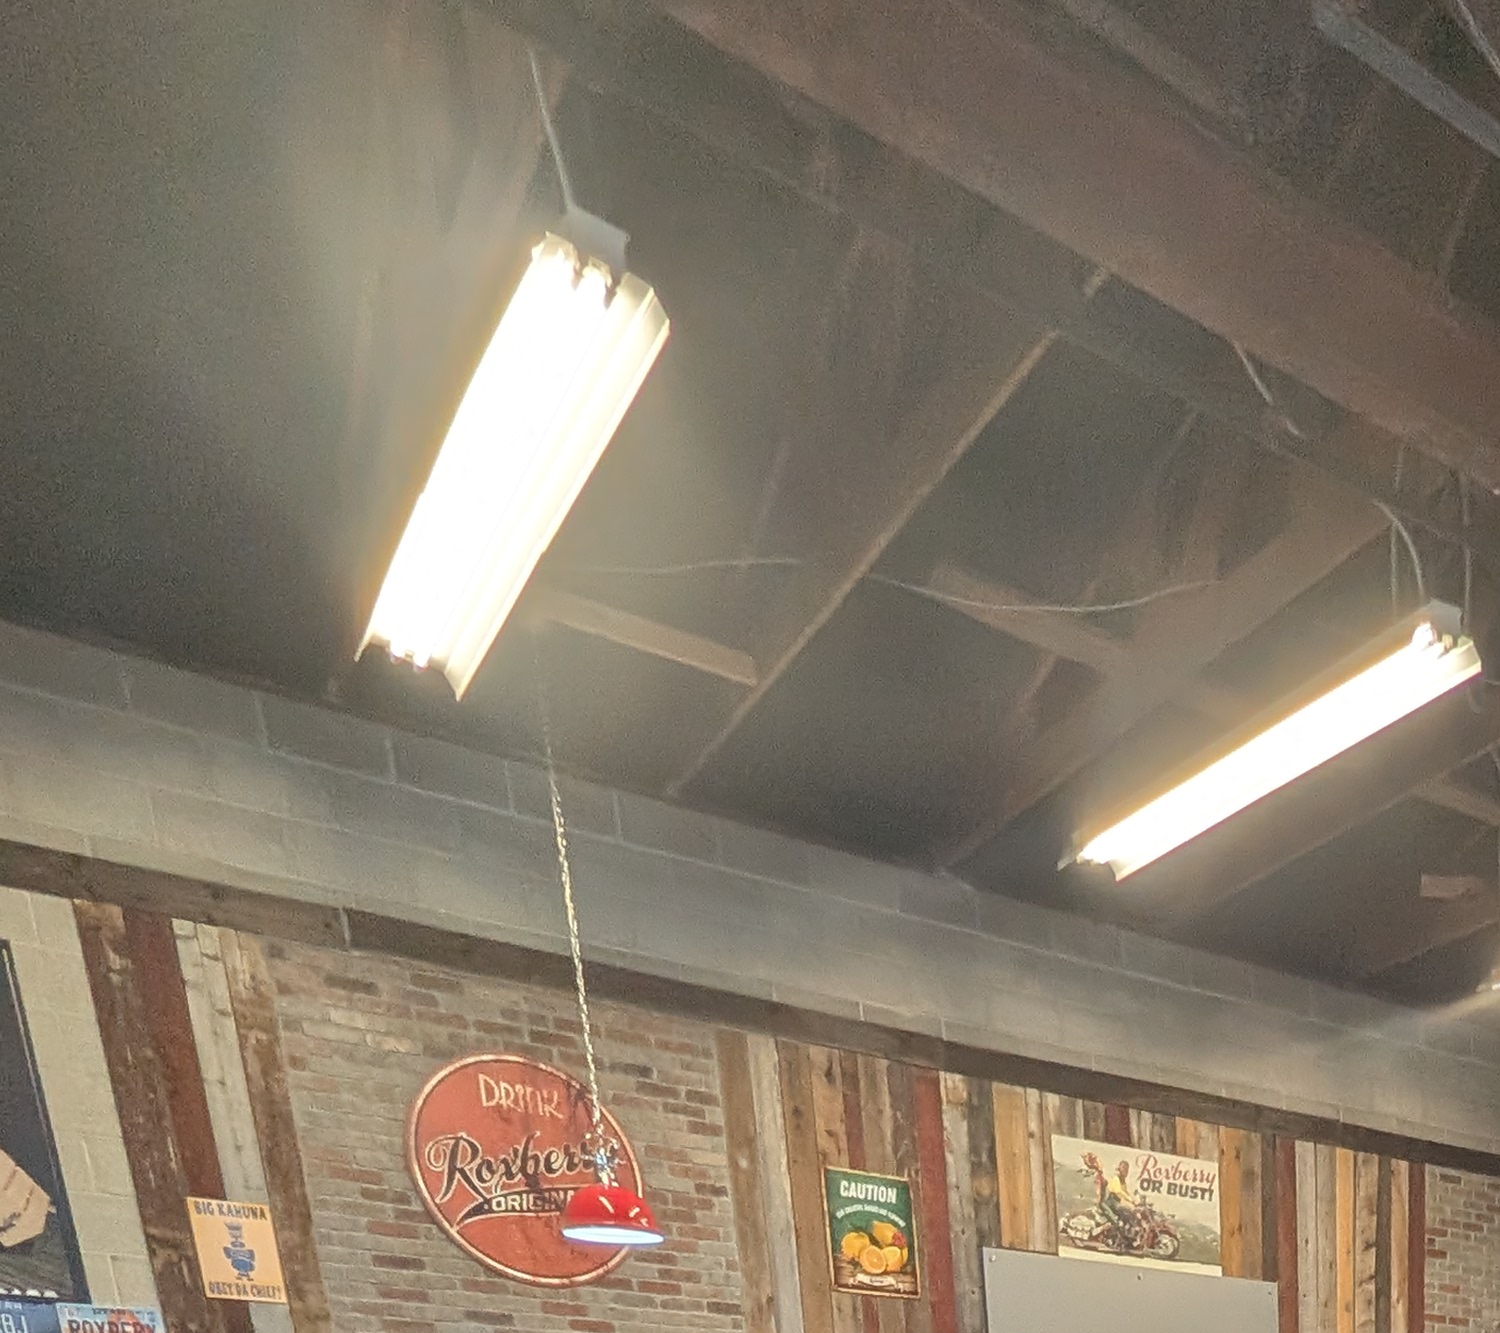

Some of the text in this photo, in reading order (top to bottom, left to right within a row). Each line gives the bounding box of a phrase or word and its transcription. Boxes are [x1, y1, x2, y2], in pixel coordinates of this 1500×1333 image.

[478, 1073, 564, 1119] DRINK
[1135, 1153, 1216, 1190] Roxberry
[840, 1180, 897, 1204] CAUTION
[1140, 1178, 1214, 1202] OR BUST!
[193, 1200, 268, 1221] BIG KAHUNA
